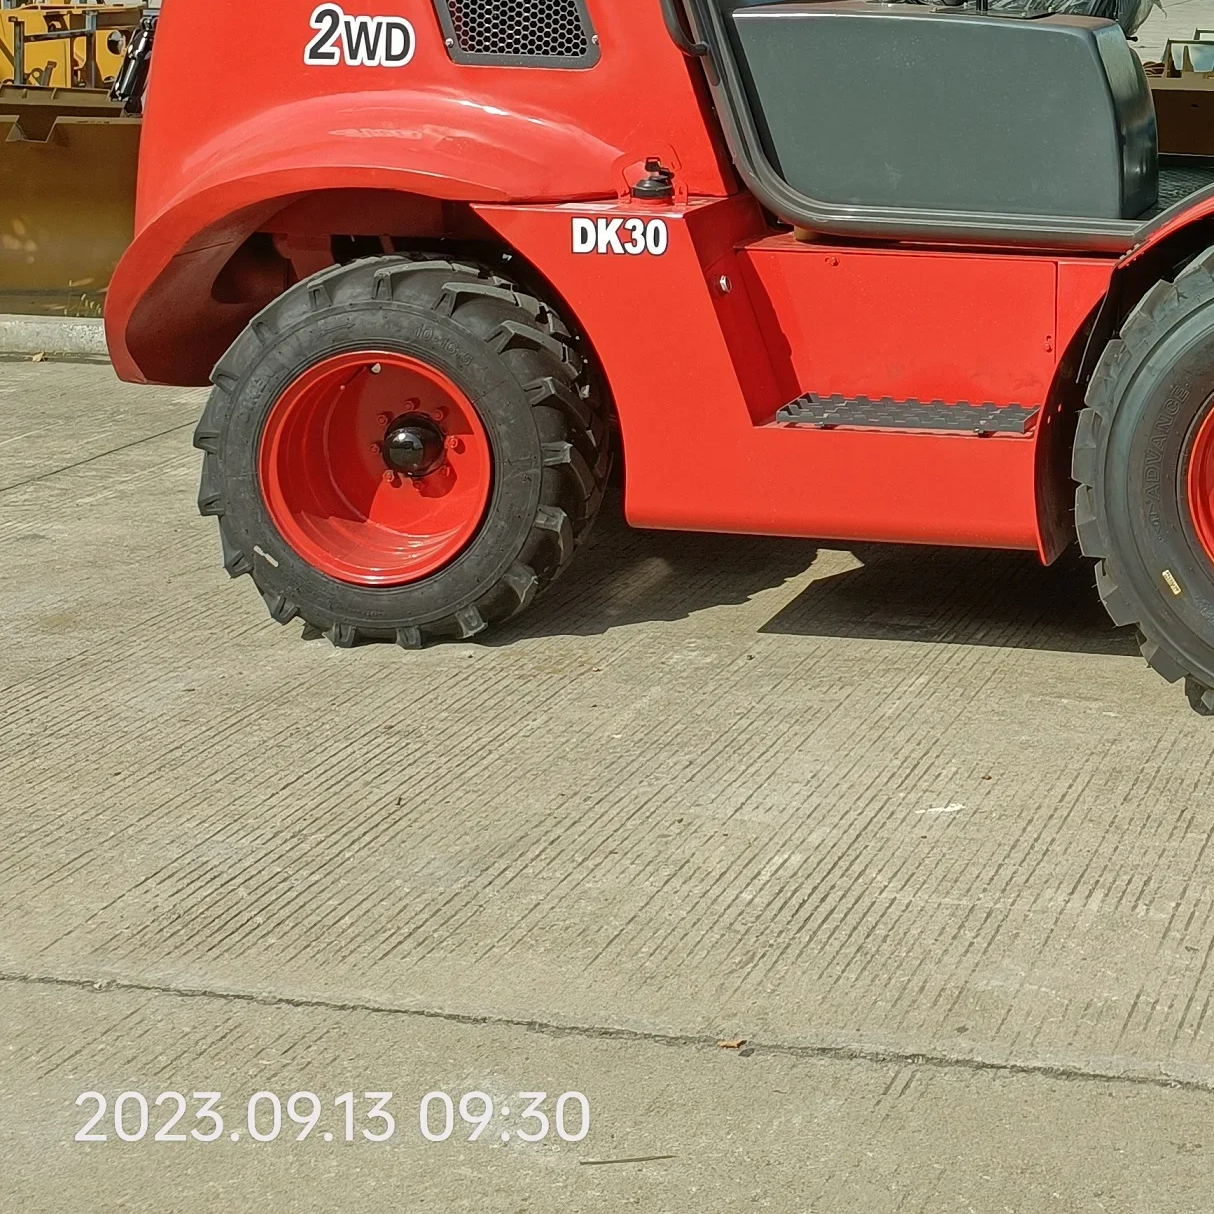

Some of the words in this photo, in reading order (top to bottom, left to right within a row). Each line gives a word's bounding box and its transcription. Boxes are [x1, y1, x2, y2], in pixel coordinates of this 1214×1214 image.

[306, 5, 413, 65] 2WD
[571, 216, 669, 256] DK30
[413, 322, 475, 367] 10-16.5
[1144, 384, 1190, 501] ADVANCE
